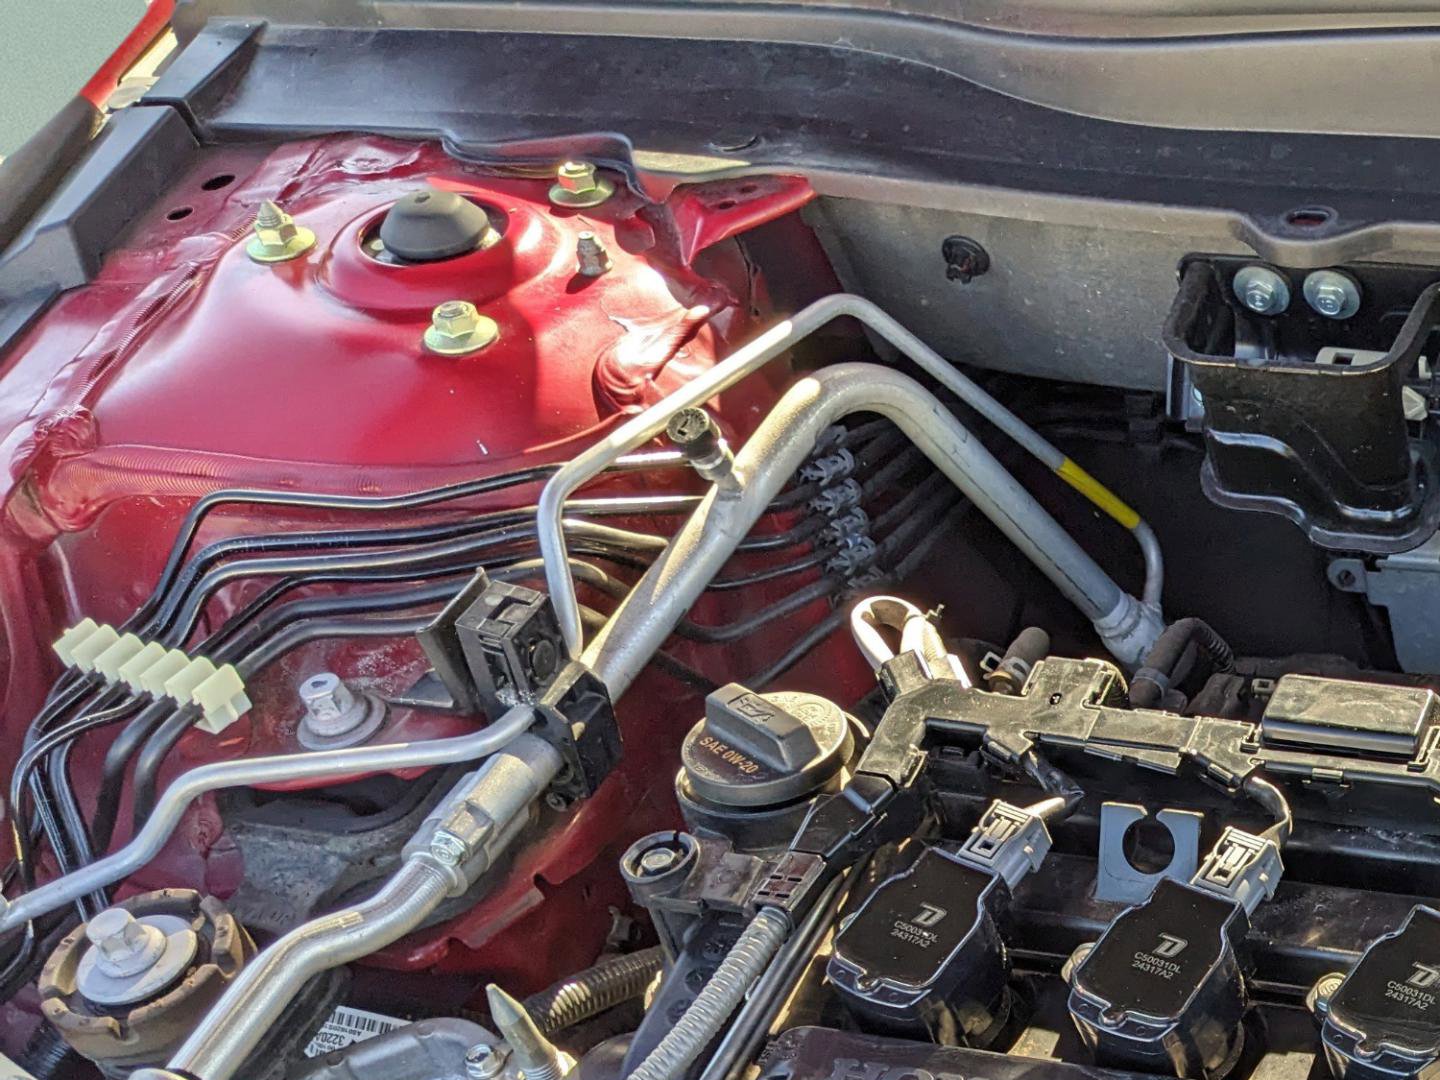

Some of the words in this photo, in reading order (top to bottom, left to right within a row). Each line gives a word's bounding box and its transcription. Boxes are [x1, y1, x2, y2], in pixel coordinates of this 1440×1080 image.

[699, 736, 728, 755] SAE
[722, 748, 759, 774] 0W-20
[890, 929, 932, 949] 24317A2
[1131, 960, 1174, 980] 24317A2
[1134, 951, 1182, 974] C50031DL
[1384, 989, 1429, 1011] 24317A2
[1387, 980, 1437, 1005] C50031DL
